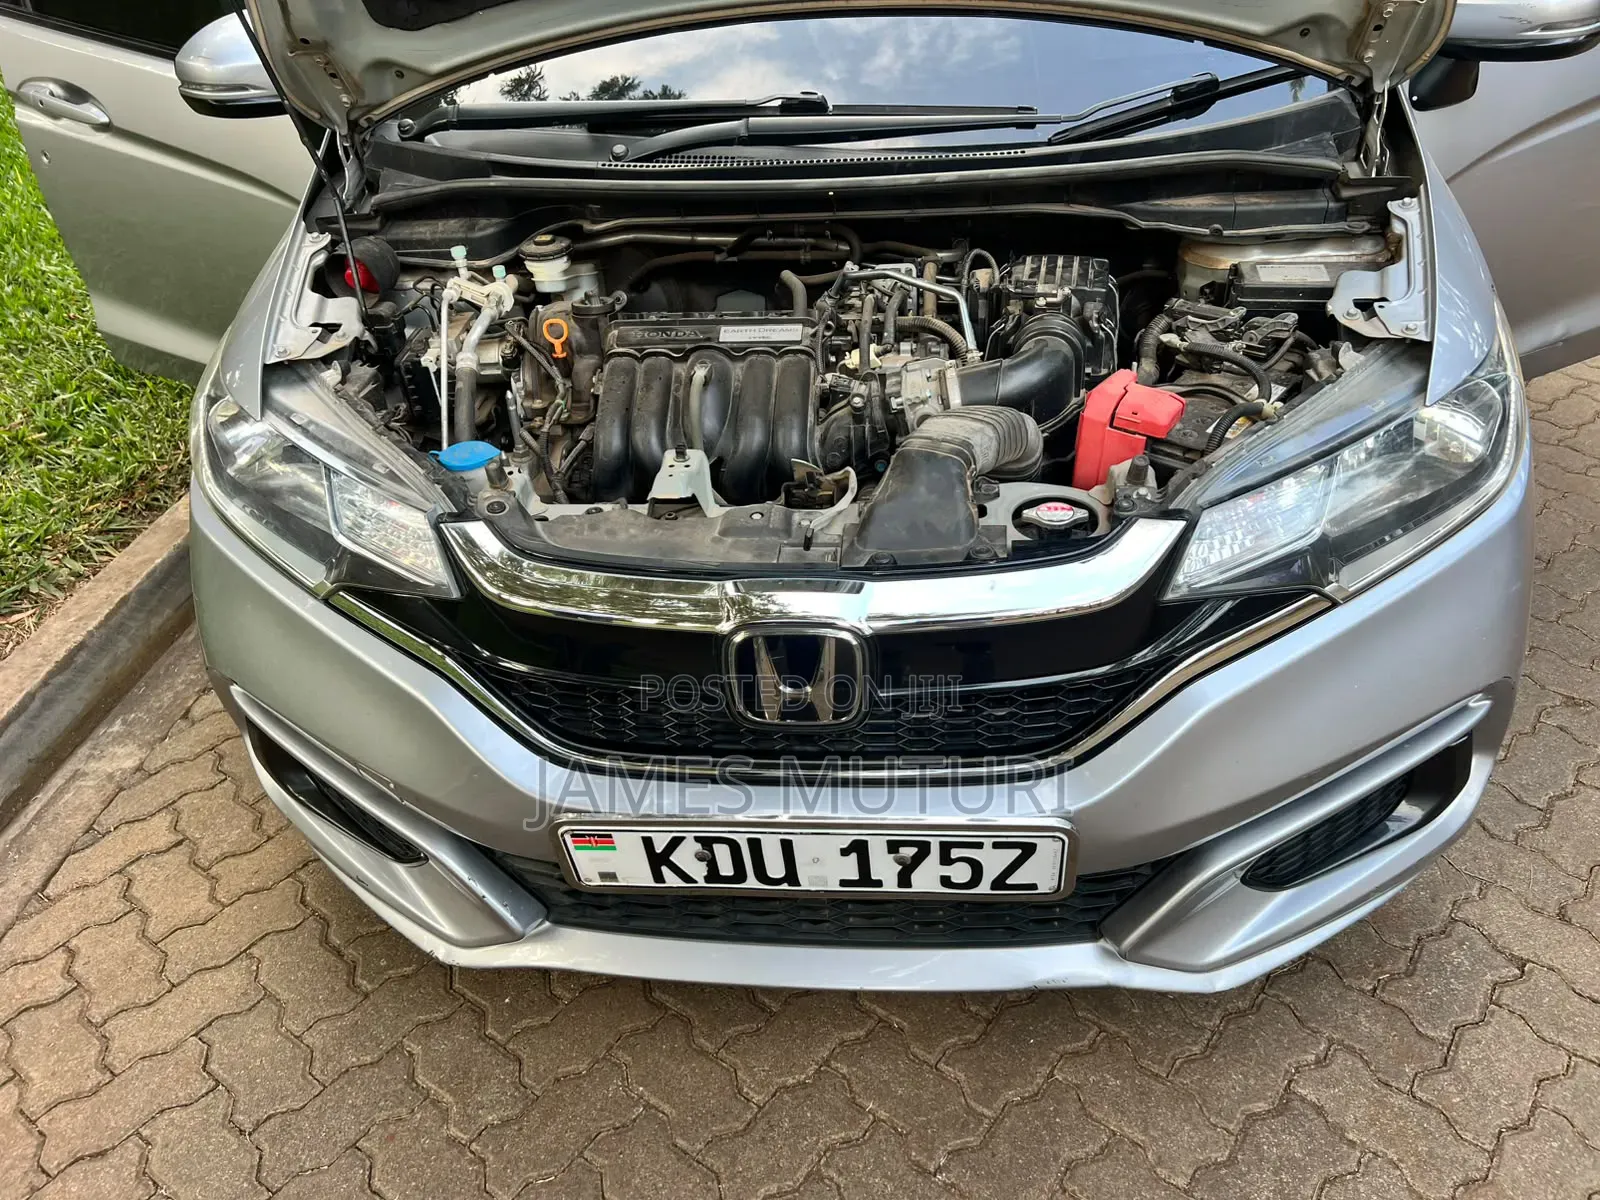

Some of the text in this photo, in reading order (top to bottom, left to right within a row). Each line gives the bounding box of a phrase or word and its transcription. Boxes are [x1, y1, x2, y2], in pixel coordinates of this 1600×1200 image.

[632, 329, 701, 339] HONDA
[640, 835, 802, 887] KDU
[838, 838, 1039, 891] 175Z
